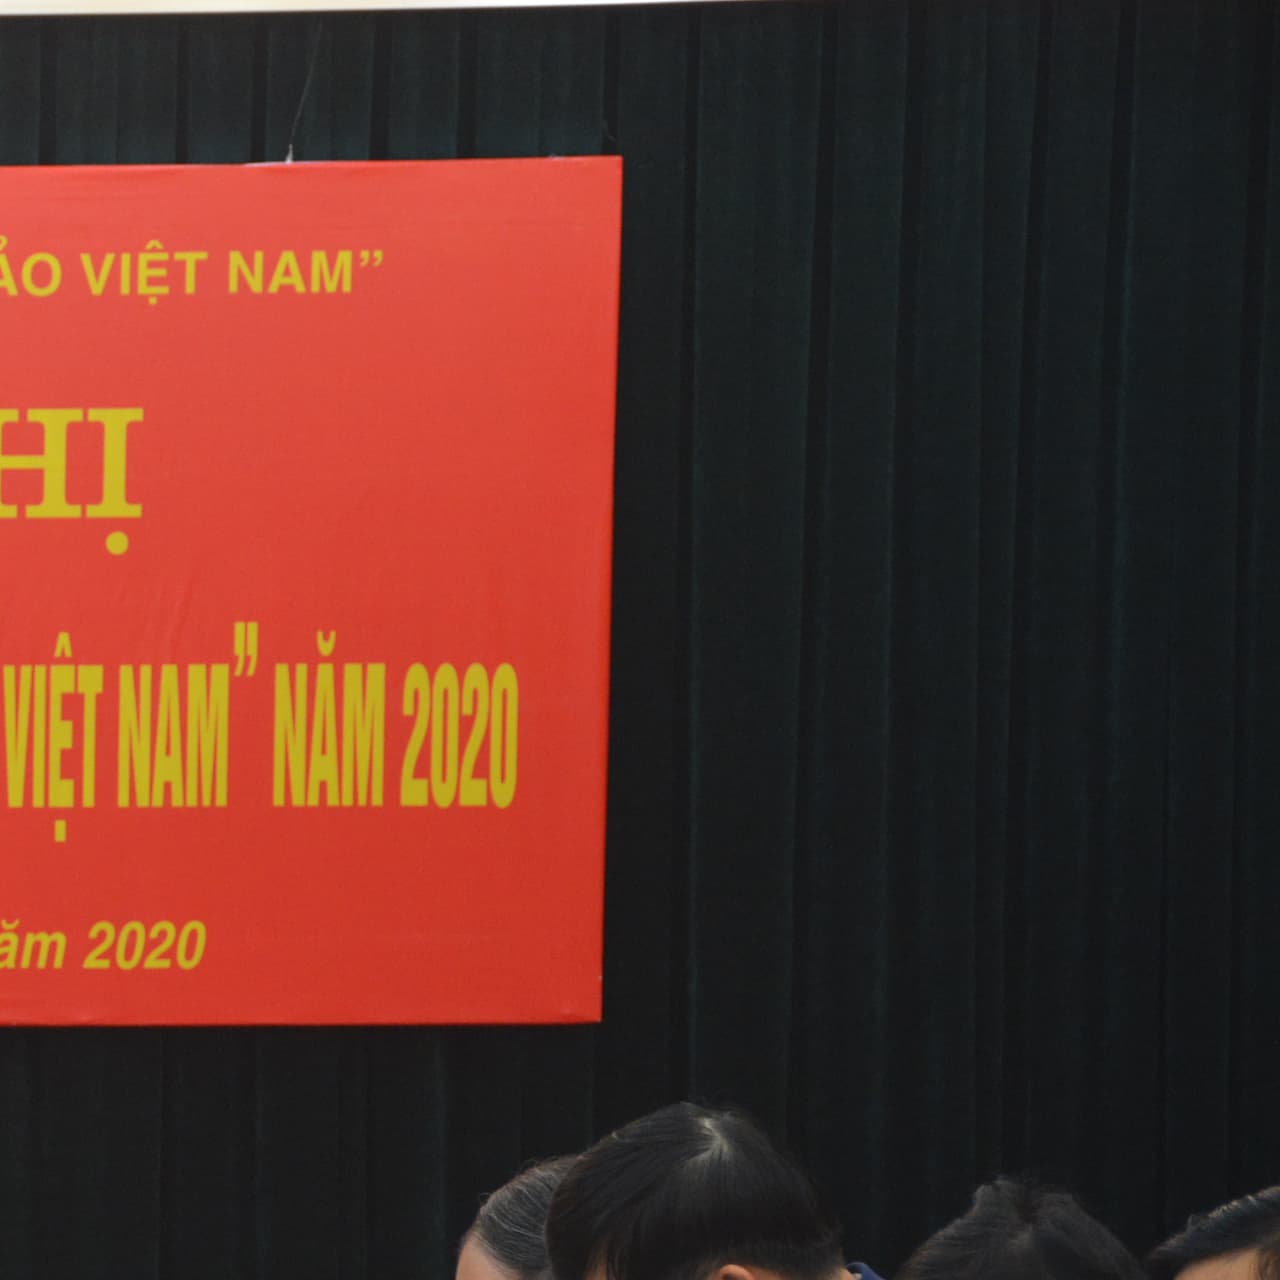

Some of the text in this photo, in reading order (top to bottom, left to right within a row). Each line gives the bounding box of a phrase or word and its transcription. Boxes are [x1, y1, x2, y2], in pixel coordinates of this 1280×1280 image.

[79, 239, 209, 305] VIỆT
[228, 249, 384, 294] NAM”
[3, 631, 104, 842] VIỆT
[117, 621, 258, 808] NAM”
[273, 631, 386, 807] NĂM
[400, 663, 519, 808] 2020
[83, 920, 206, 970] 2020
